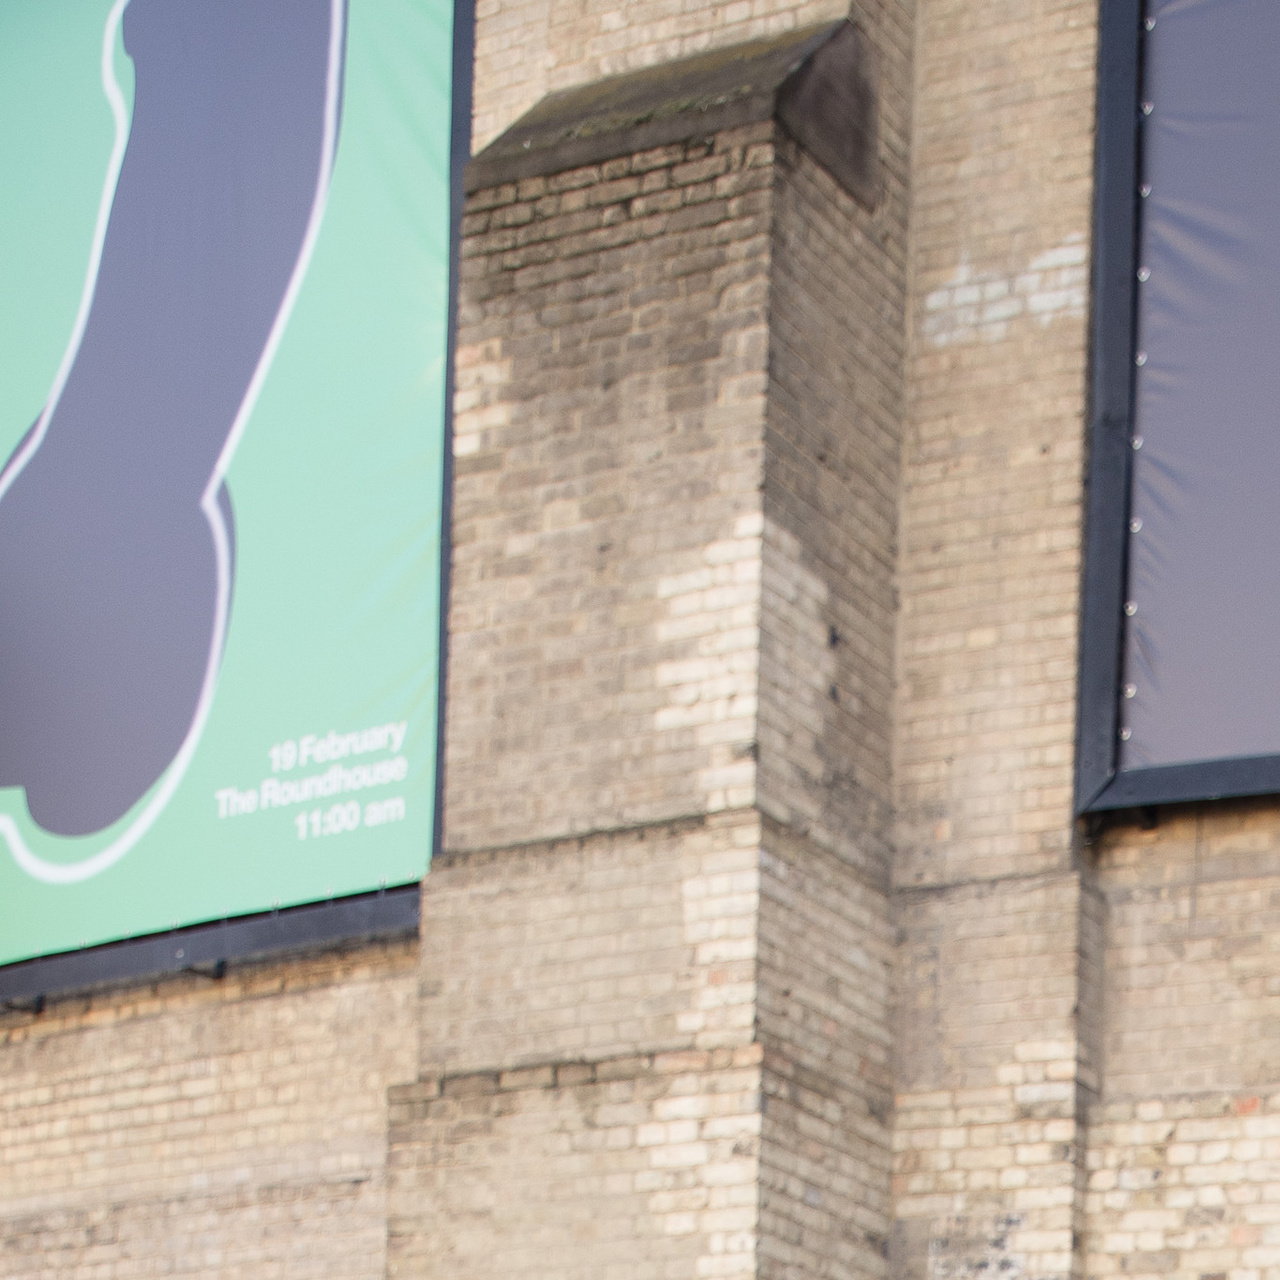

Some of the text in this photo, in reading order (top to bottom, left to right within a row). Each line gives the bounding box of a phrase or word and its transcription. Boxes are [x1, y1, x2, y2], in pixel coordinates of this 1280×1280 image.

[268, 721, 408, 773] 19 February
[215, 755, 408, 819] The Roundhouse
[294, 796, 406, 840] 11:00 am
